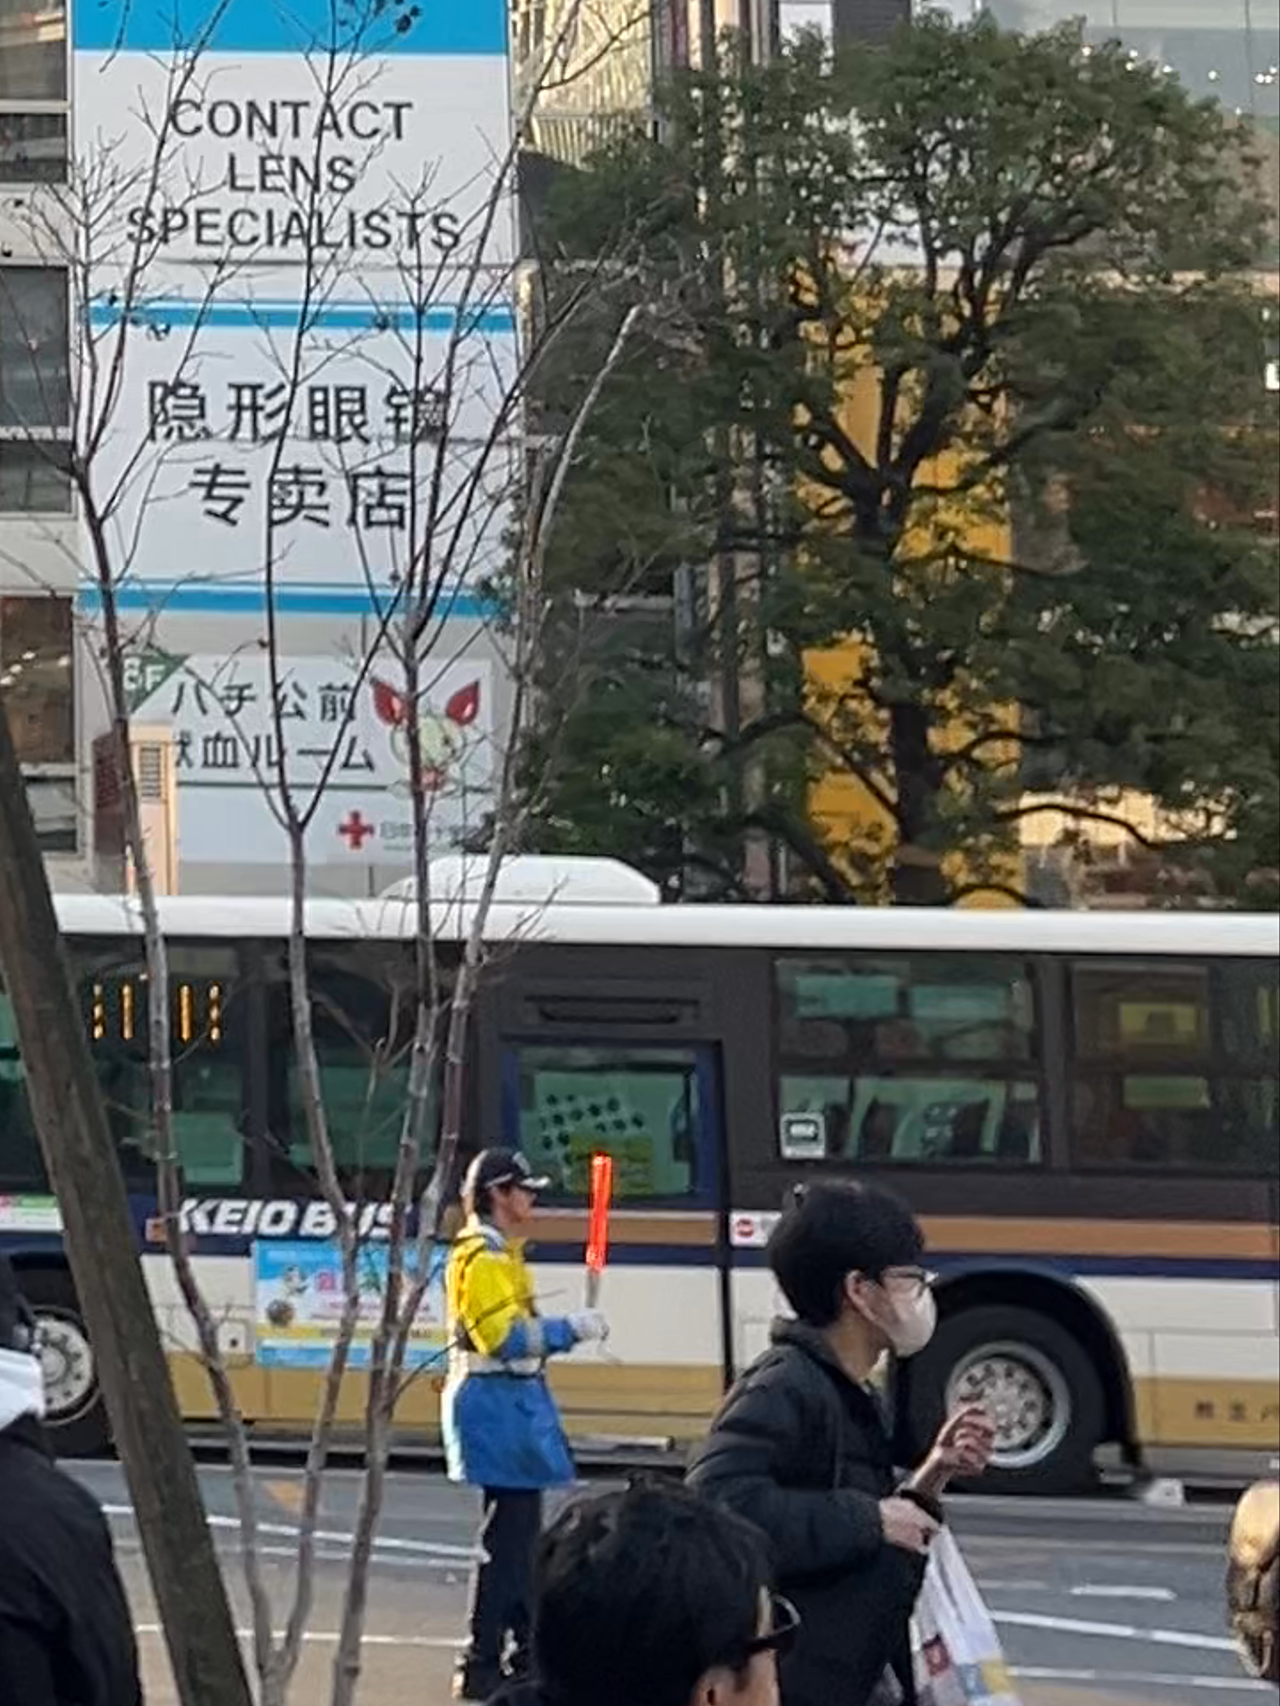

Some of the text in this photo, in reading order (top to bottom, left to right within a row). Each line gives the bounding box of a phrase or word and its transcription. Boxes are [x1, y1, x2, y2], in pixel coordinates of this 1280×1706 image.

[170, 98, 413, 144] CONTACT
[228, 153, 356, 195] LENS
[125, 208, 462, 252] SPECIALISTS
[172, 682, 360, 723] ハチ公前
[177, 1197, 415, 1239] KEIO BUS
